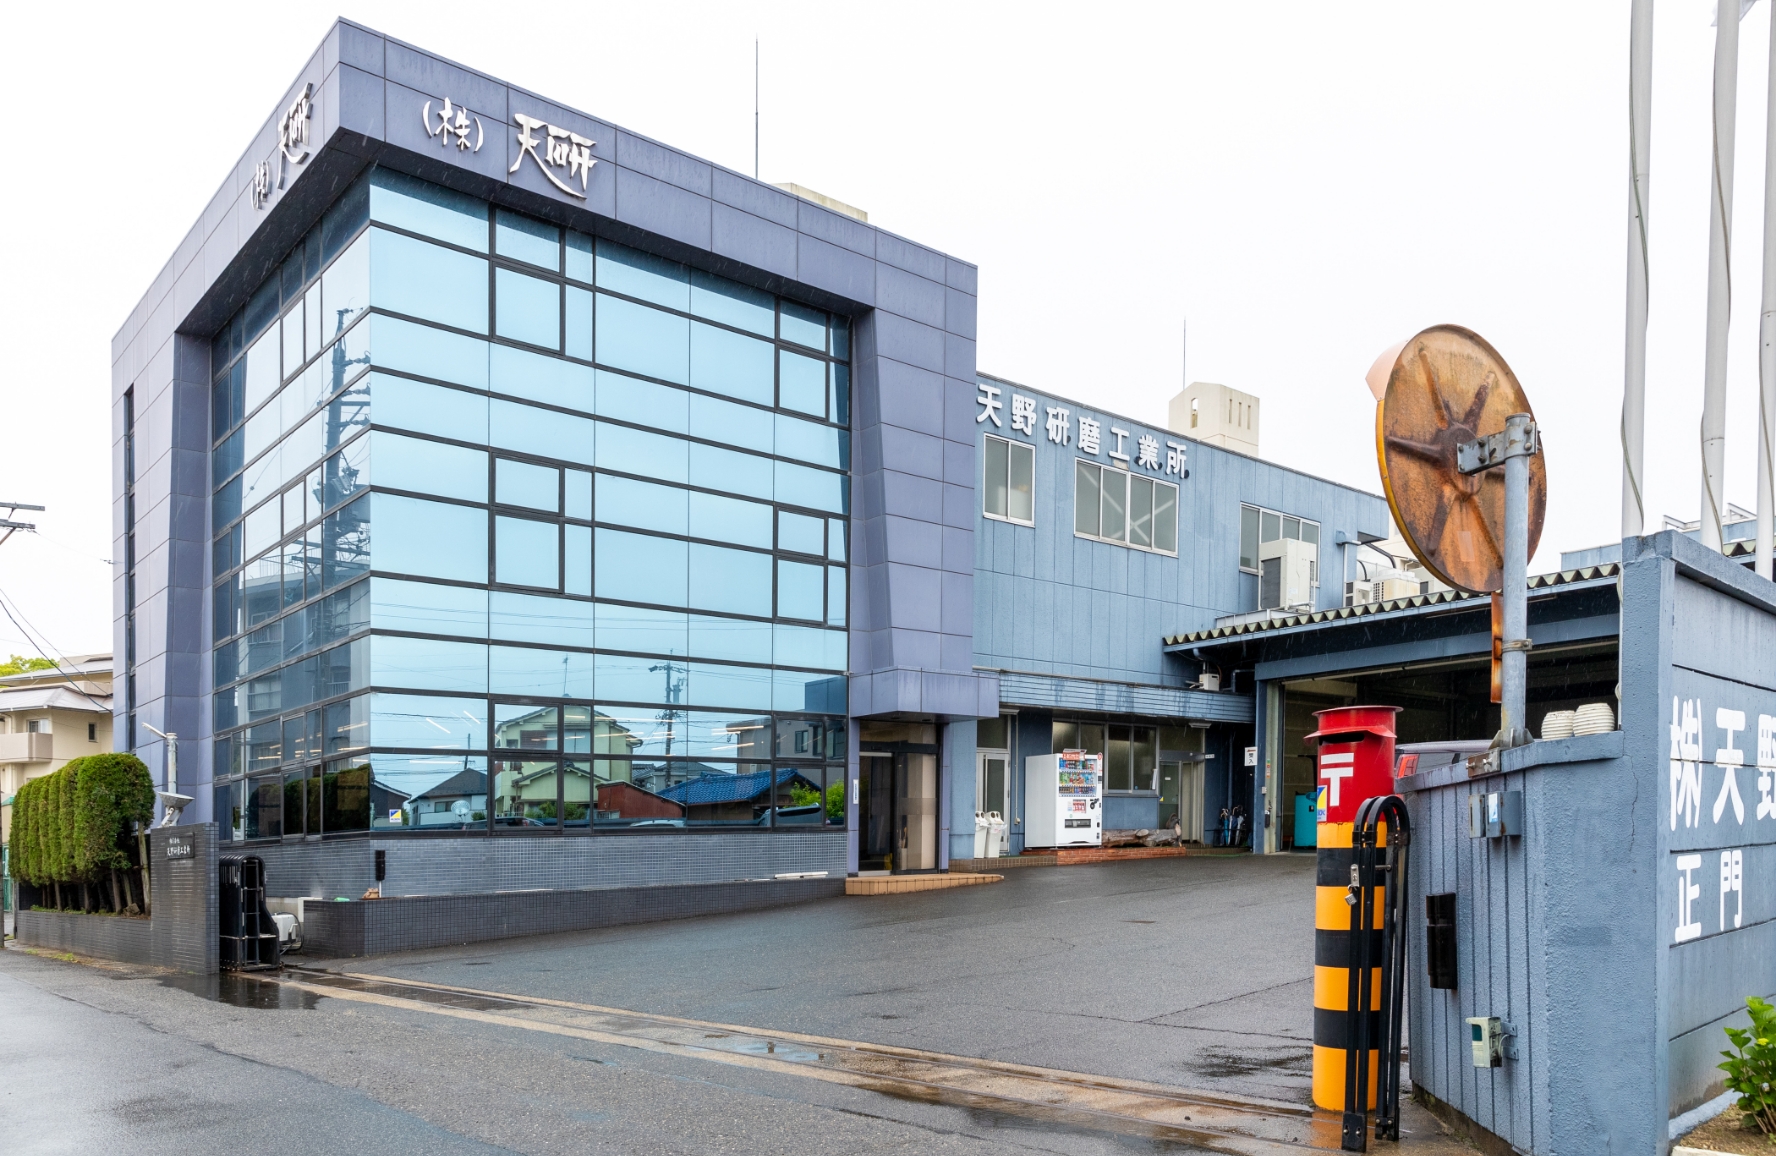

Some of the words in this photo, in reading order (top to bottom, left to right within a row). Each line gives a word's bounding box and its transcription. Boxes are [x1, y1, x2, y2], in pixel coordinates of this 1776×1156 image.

[422, 97, 484, 153] (株)
[509, 113, 598, 200] 天研
[976, 383, 1187, 479] 天野研磨工業所
[1675, 850, 1742, 943] 正門
